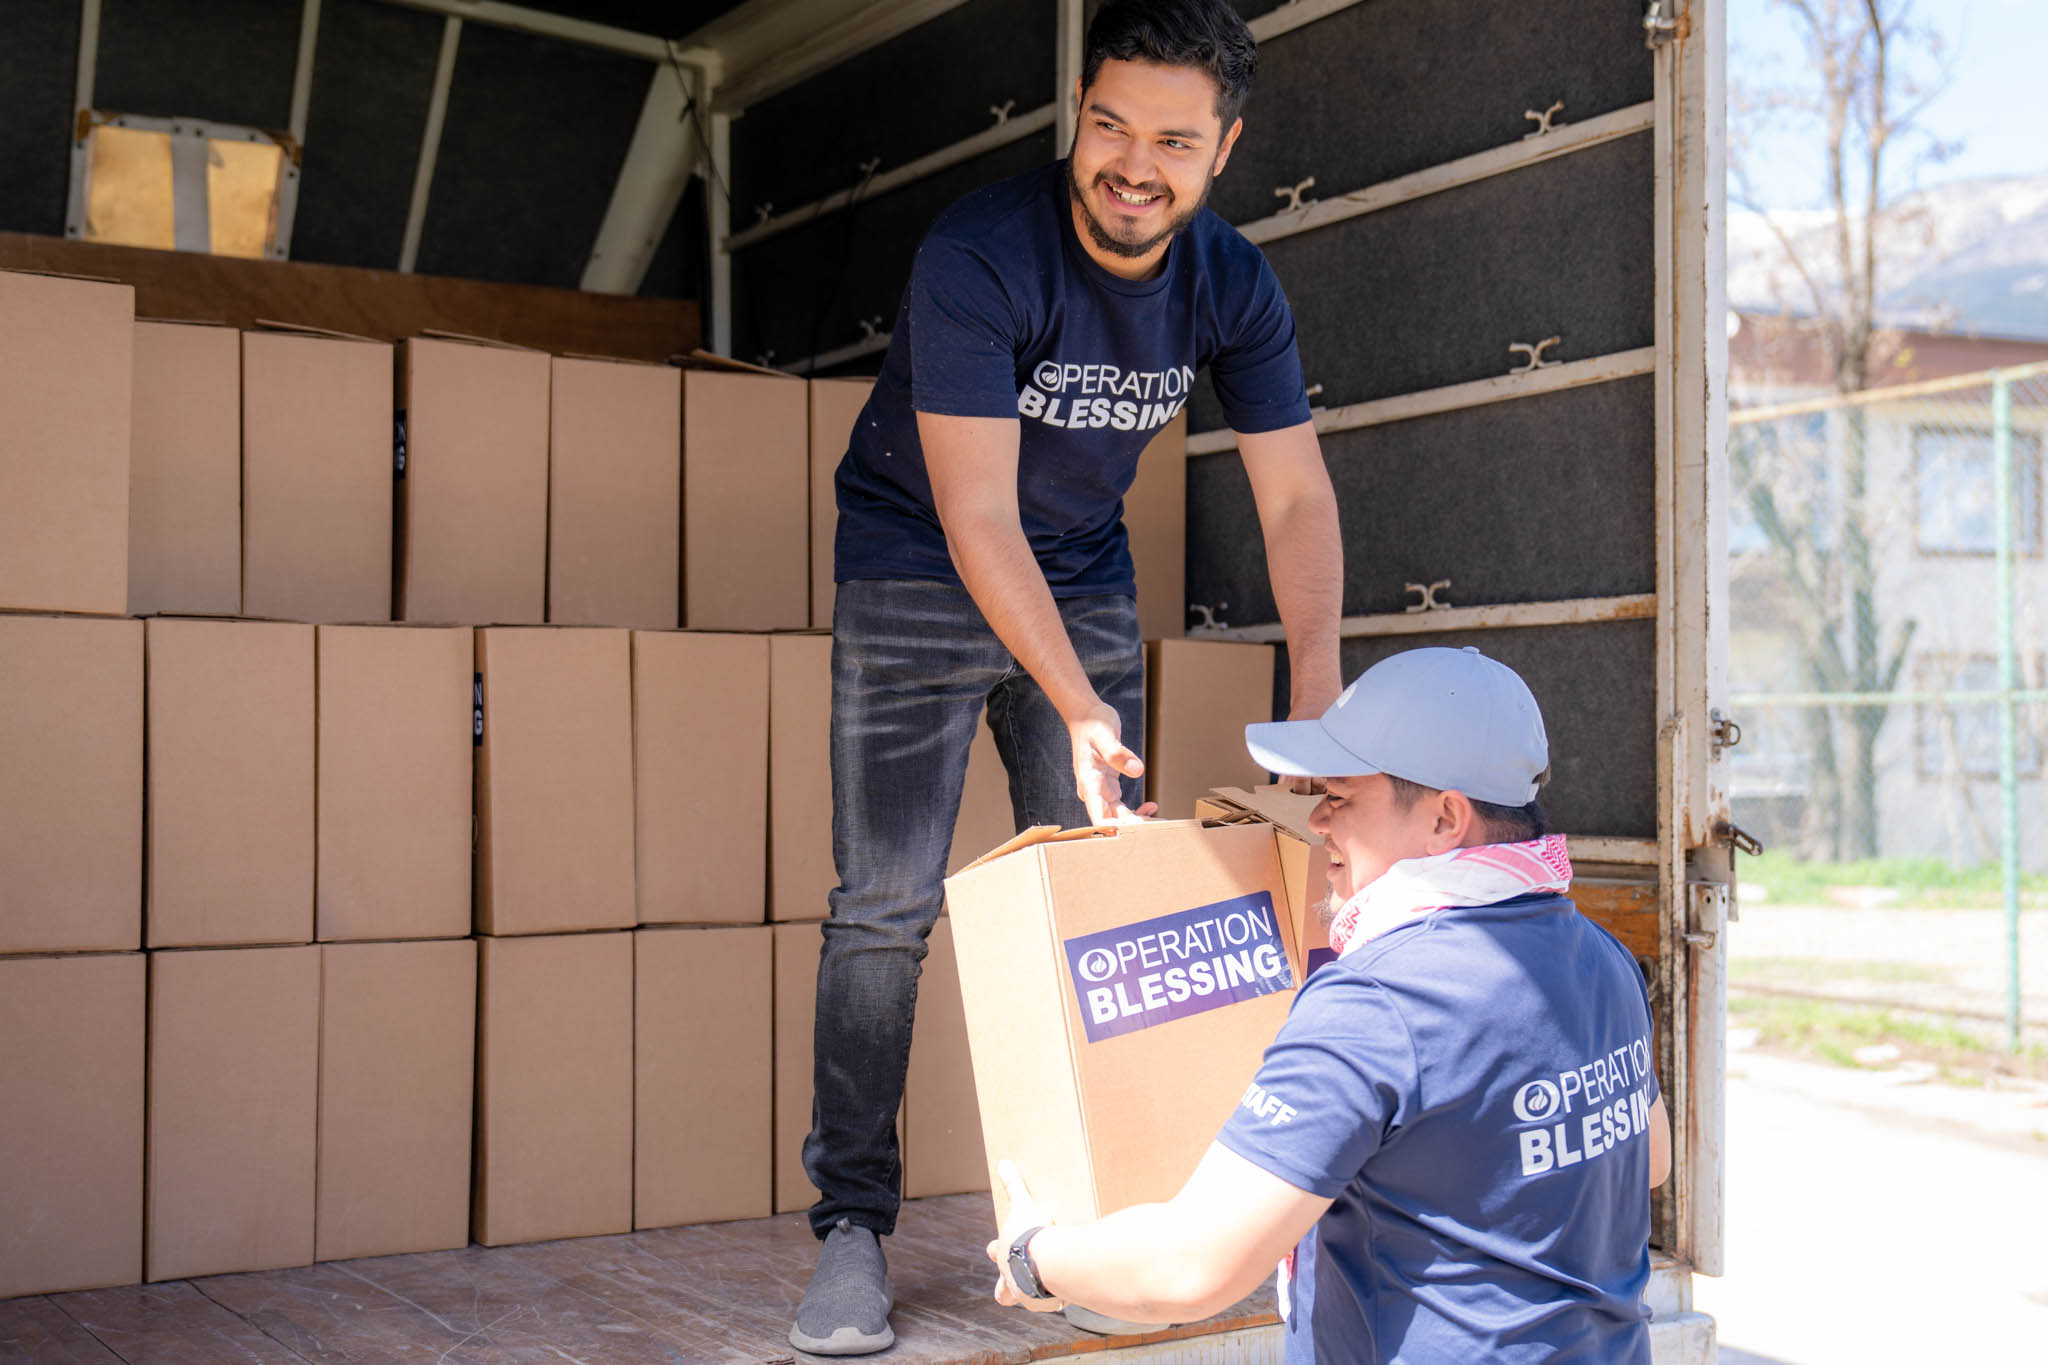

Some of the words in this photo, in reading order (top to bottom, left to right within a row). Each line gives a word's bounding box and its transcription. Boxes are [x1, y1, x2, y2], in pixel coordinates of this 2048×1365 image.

[1033, 360, 1195, 400] OPERATION
[1078, 906, 1273, 982] OPERATION
[1087, 944, 1282, 1025] BLESSING
[1519, 1083, 1650, 1176] BLESSIN
